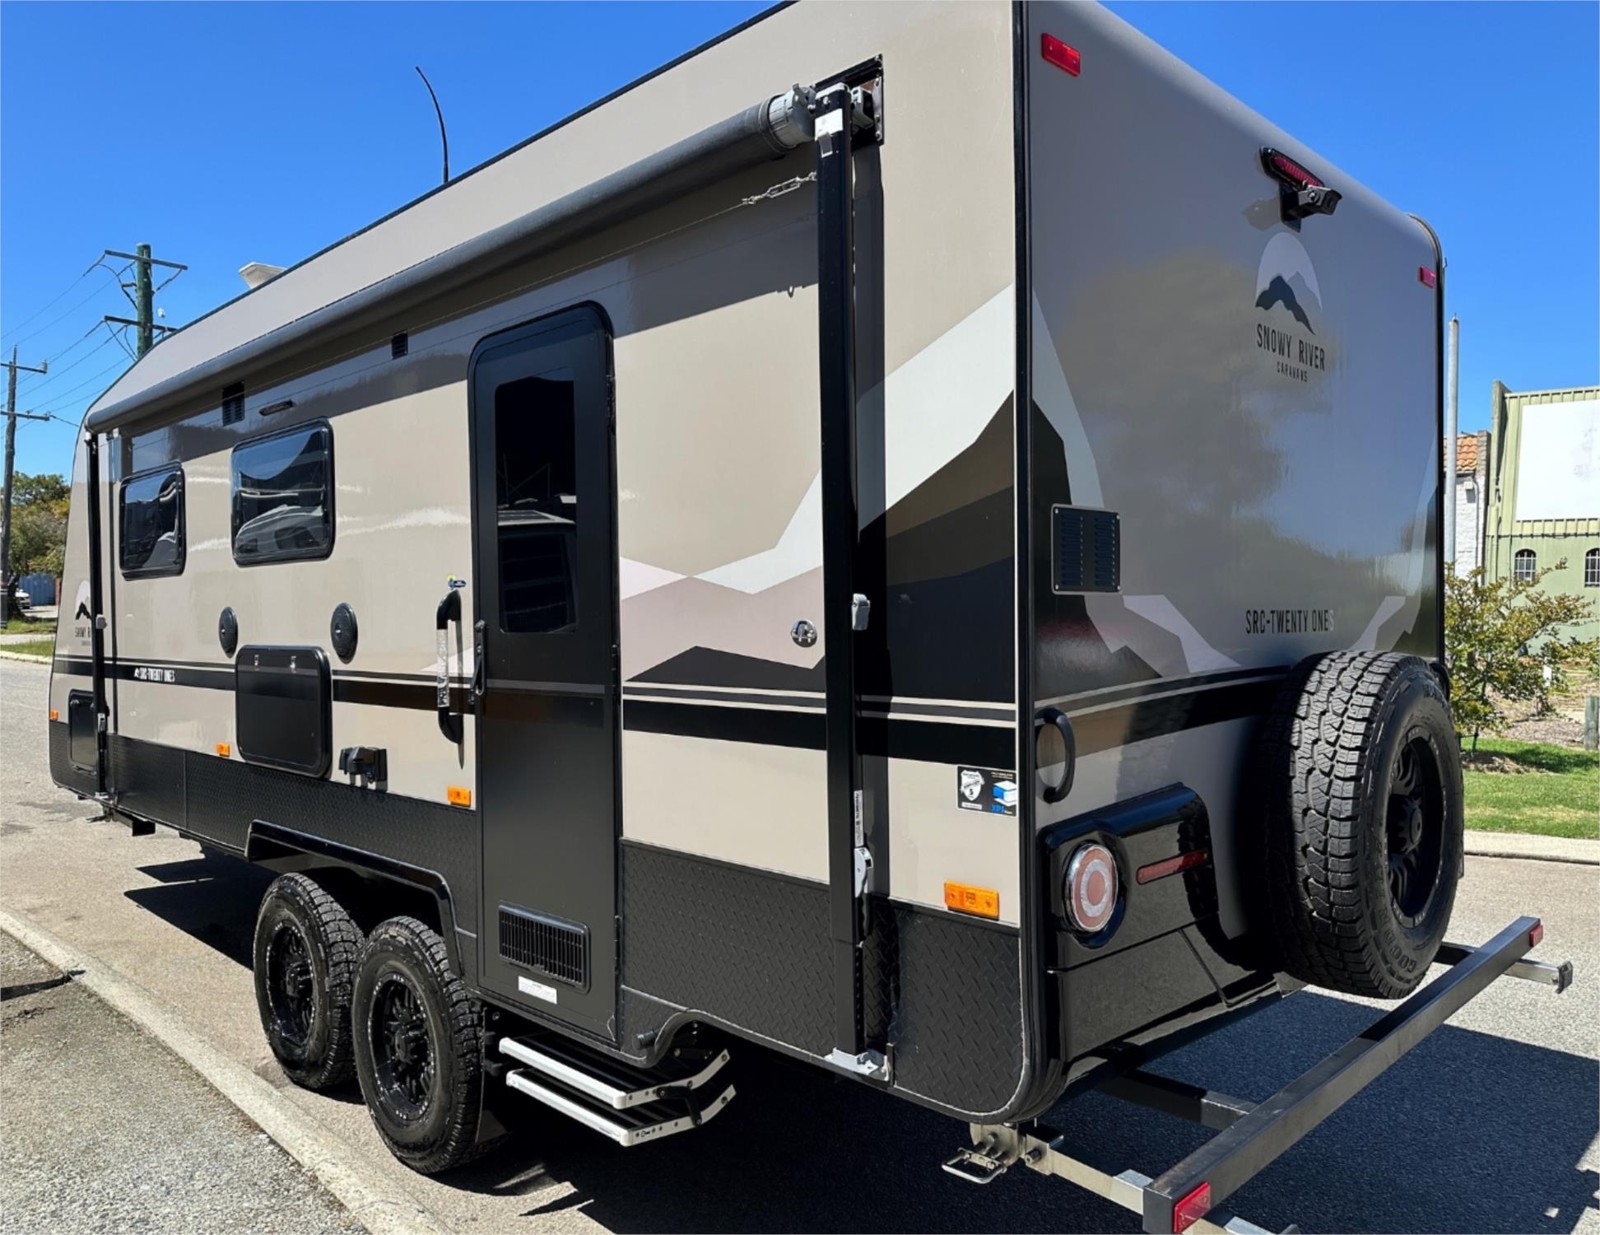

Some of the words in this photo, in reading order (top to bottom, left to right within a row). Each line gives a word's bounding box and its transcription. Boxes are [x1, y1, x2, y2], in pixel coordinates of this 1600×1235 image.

[1257, 323, 1292, 358] SNOWY
[1298, 339, 1325, 371] RIVER
[1277, 361, 1307, 382] CARAVANS
[1245, 609, 1308, 634] SRC-TWENTY
